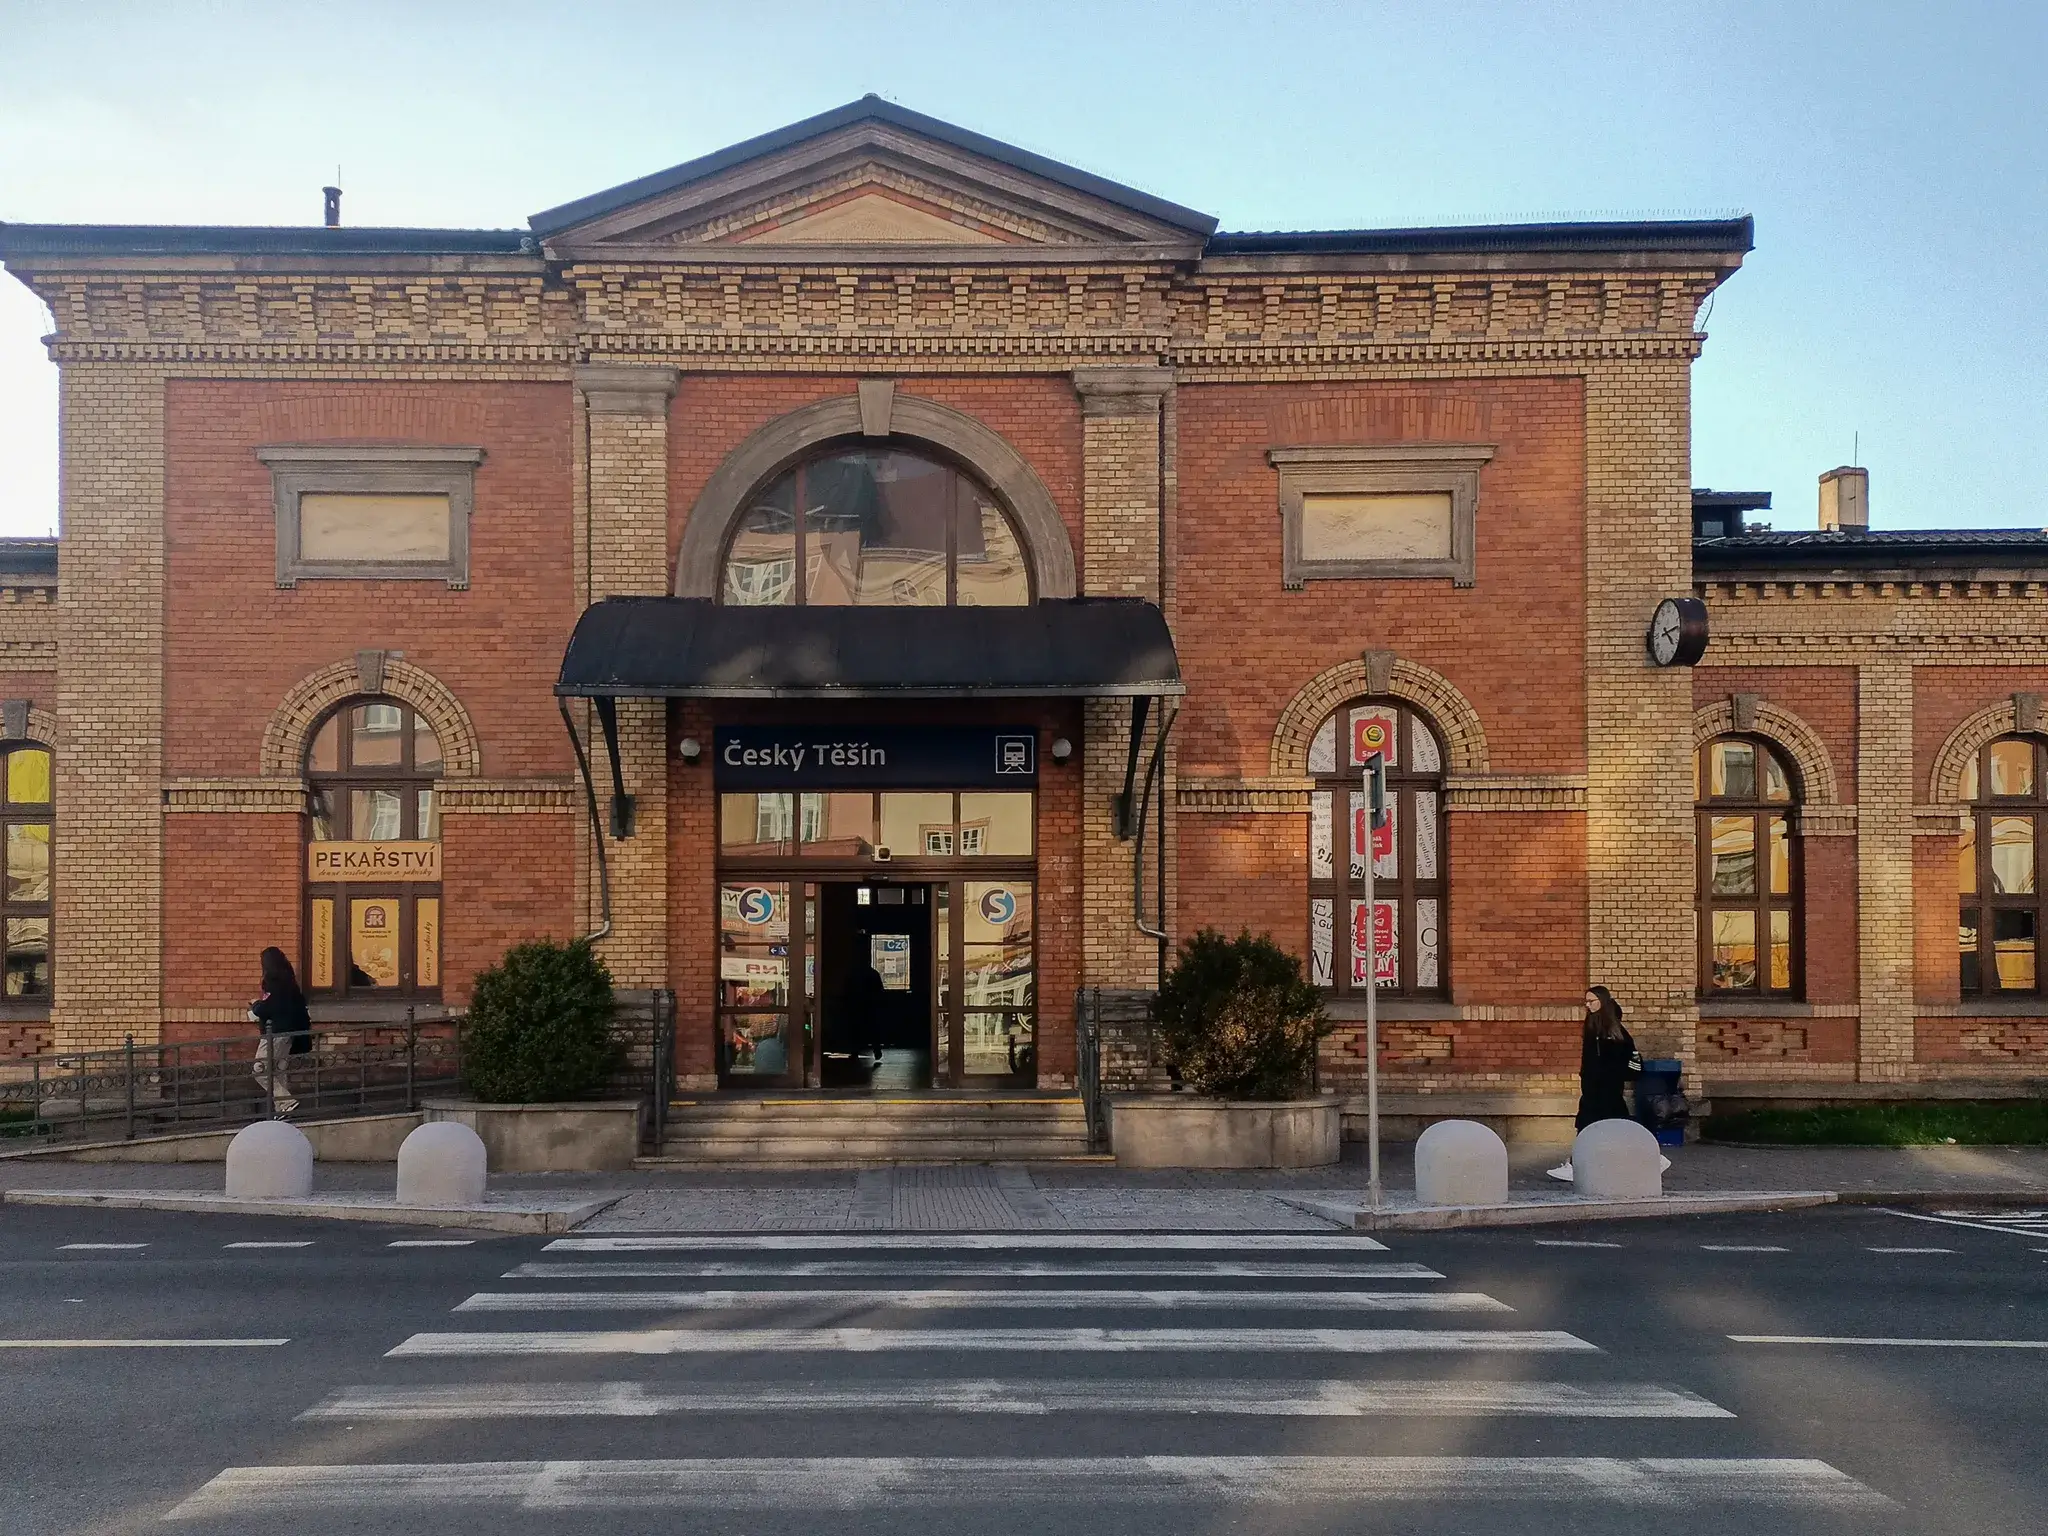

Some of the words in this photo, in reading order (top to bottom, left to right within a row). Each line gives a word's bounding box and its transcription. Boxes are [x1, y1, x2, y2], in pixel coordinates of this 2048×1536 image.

[724, 739, 805, 772] Český
[812, 742, 886, 766] Těšín
[316, 845, 436, 867] PEKAŘSTVÍ
